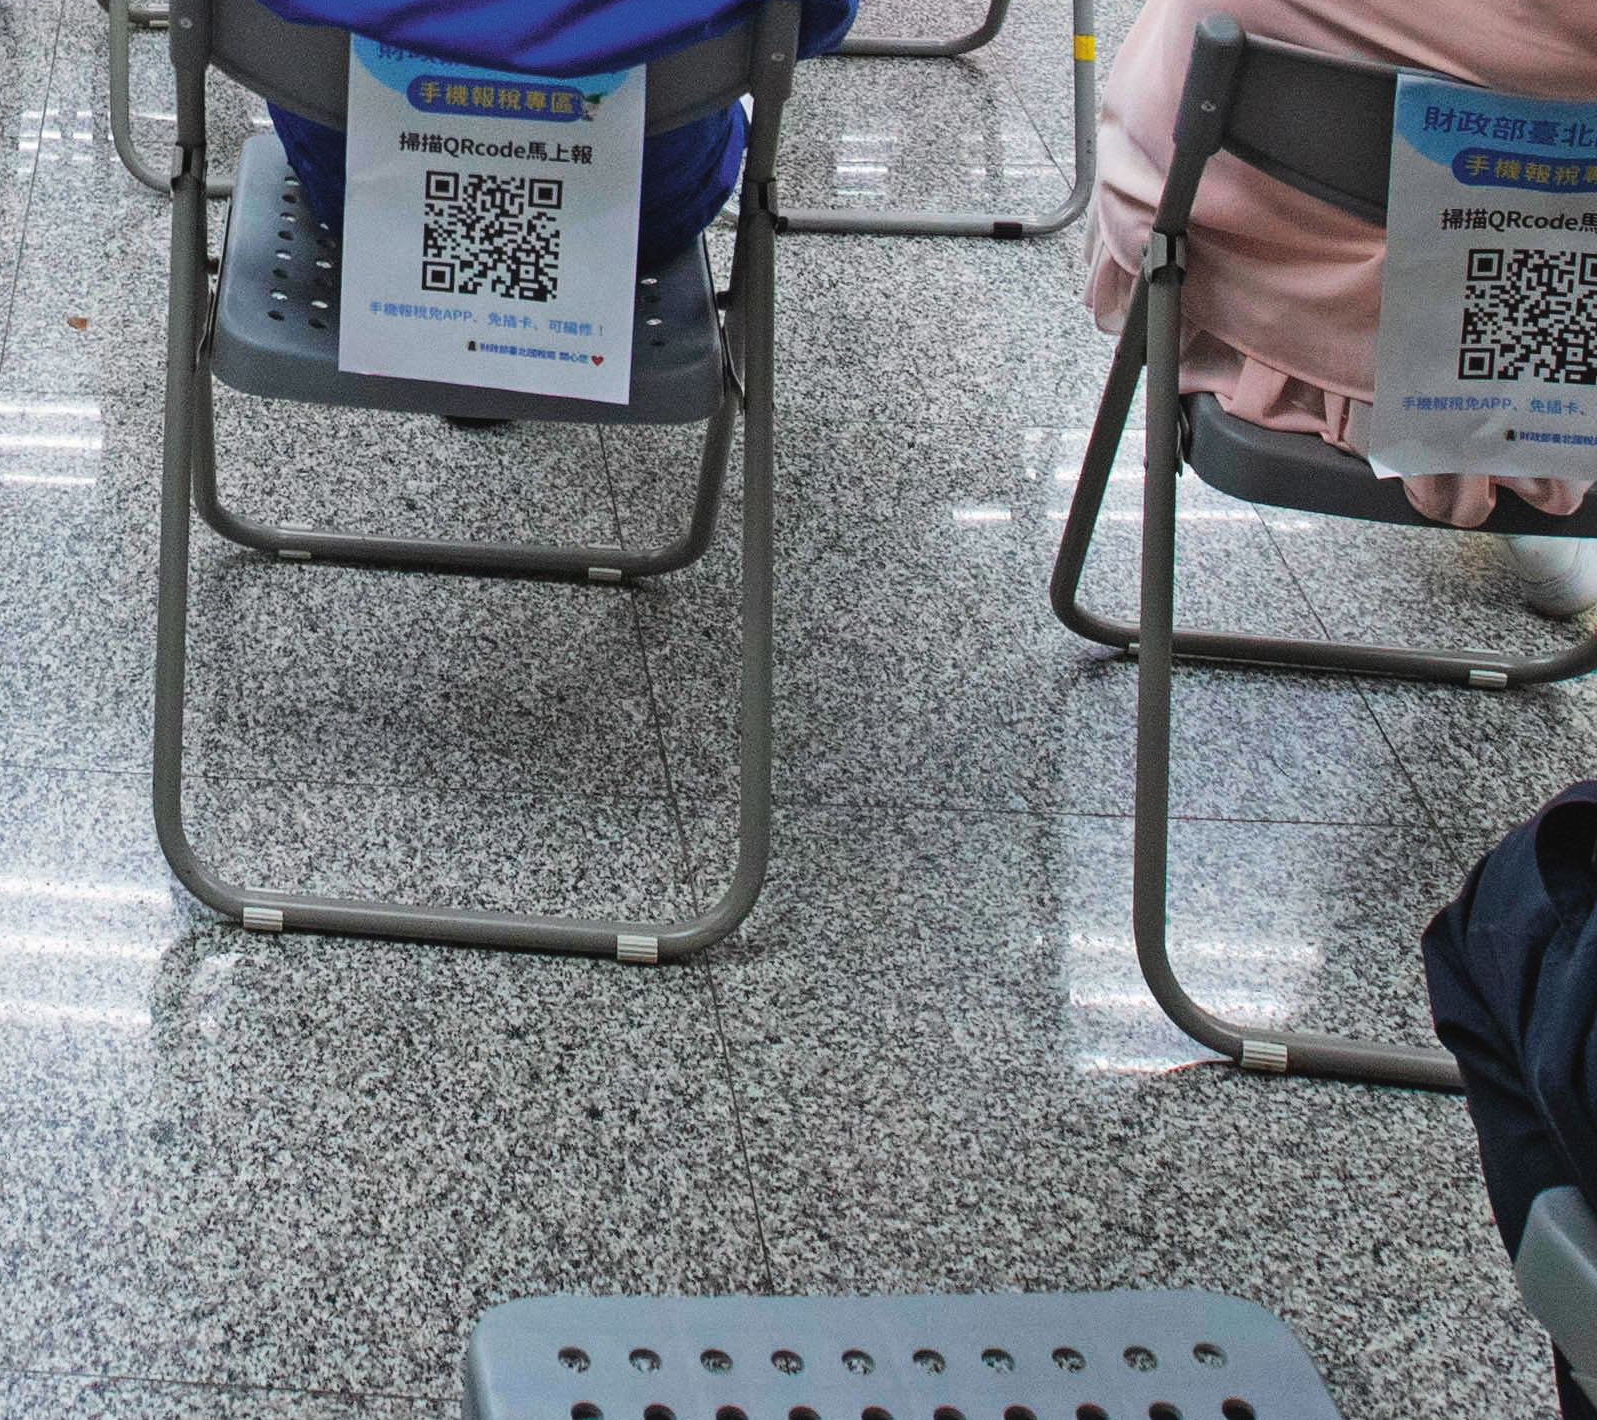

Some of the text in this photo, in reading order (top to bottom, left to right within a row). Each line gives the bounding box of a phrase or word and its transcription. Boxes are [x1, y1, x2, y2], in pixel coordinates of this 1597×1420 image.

[420, 82, 574, 114] 手機報稅專區
[399, 131, 593, 166] 掃描QRcode馬上報
